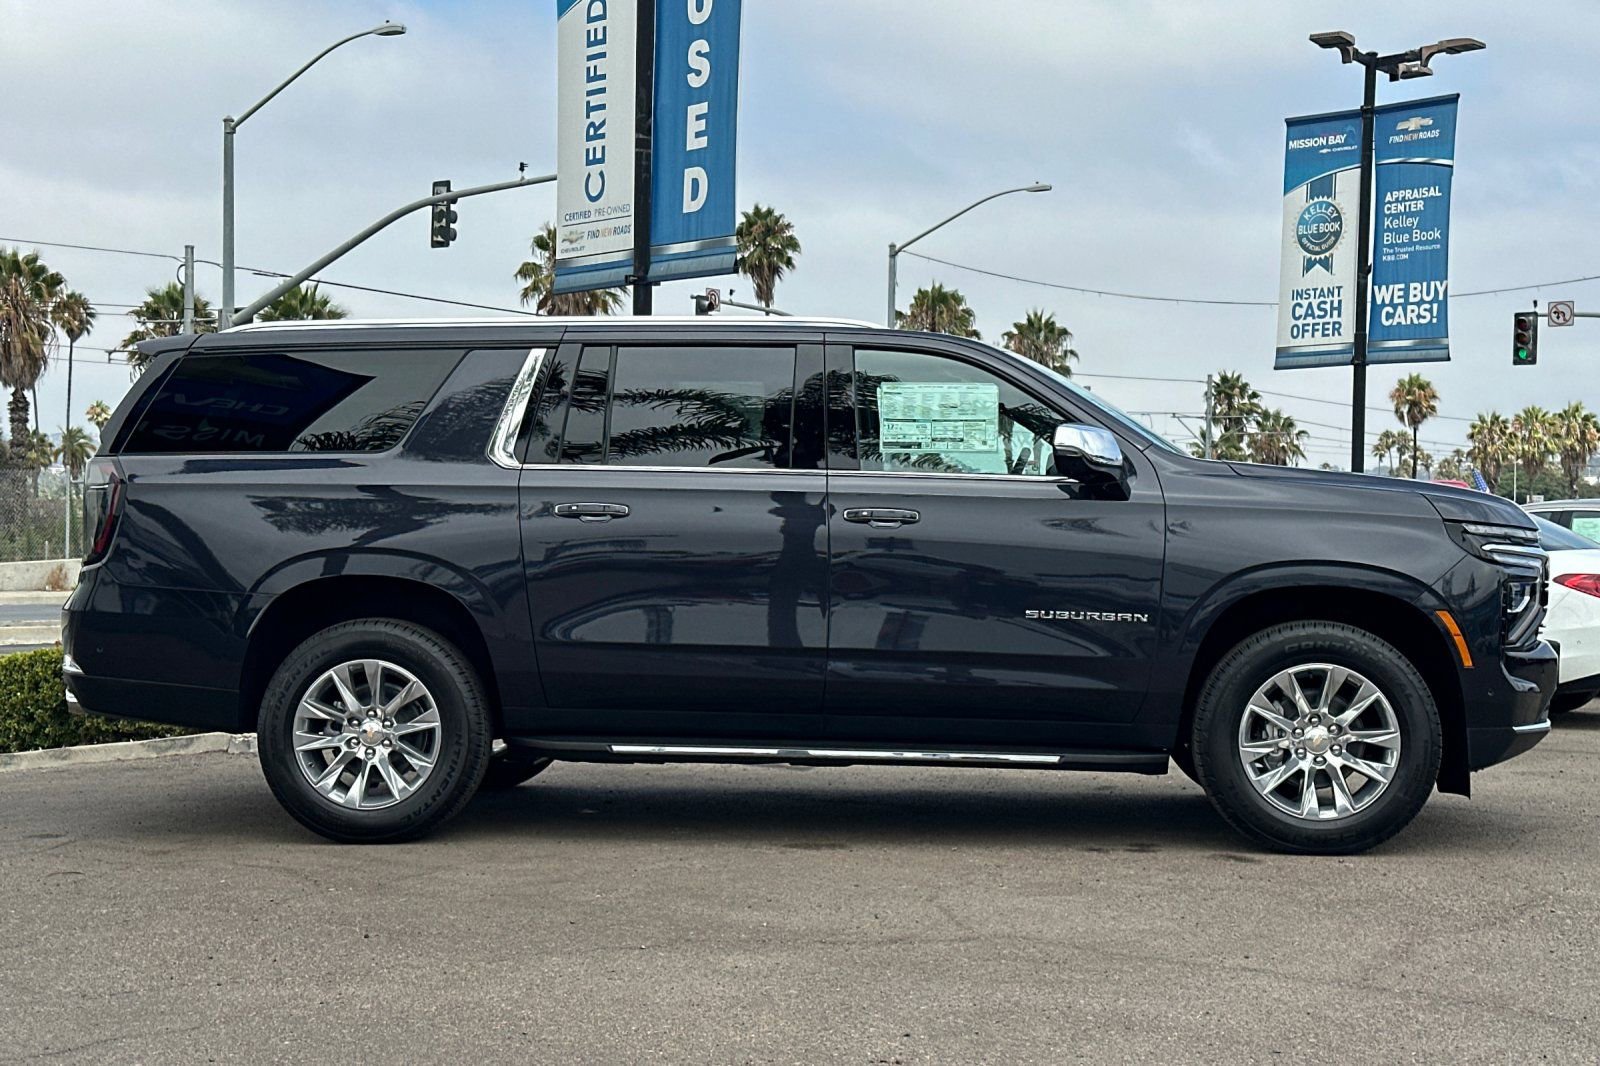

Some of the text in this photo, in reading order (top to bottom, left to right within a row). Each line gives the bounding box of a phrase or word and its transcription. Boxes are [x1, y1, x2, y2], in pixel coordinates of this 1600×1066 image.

[585, 0, 607, 203] CERTIFIED
[1288, 133, 1347, 150] MISSION BAY
[1384, 185, 1443, 203] APPRAISAL
[564, 203, 631, 222] CERTIFIED PRE-OWNED
[1302, 203, 1339, 221] KELLEY
[1384, 200, 1425, 215] CENTER
[1298, 221, 1341, 235] BLUE BOOK
[1384, 214, 1420, 229] Kelley
[586, 229, 600, 241] FIND
[613, 224, 632, 236] ROADS
[1383, 227, 1442, 245] Blue Book
[1382, 247, 1394, 255] The
[1394, 245, 1415, 253] Trusted
[1291, 286, 1343, 301] INSTANT
[1373, 280, 1448, 305] WE BUY
[1291, 299, 1342, 321] CASH
[1380, 303, 1438, 326] CARS!
[1290, 320, 1342, 339] OFFER
[1025, 609, 1149, 623] SUBURBAN
